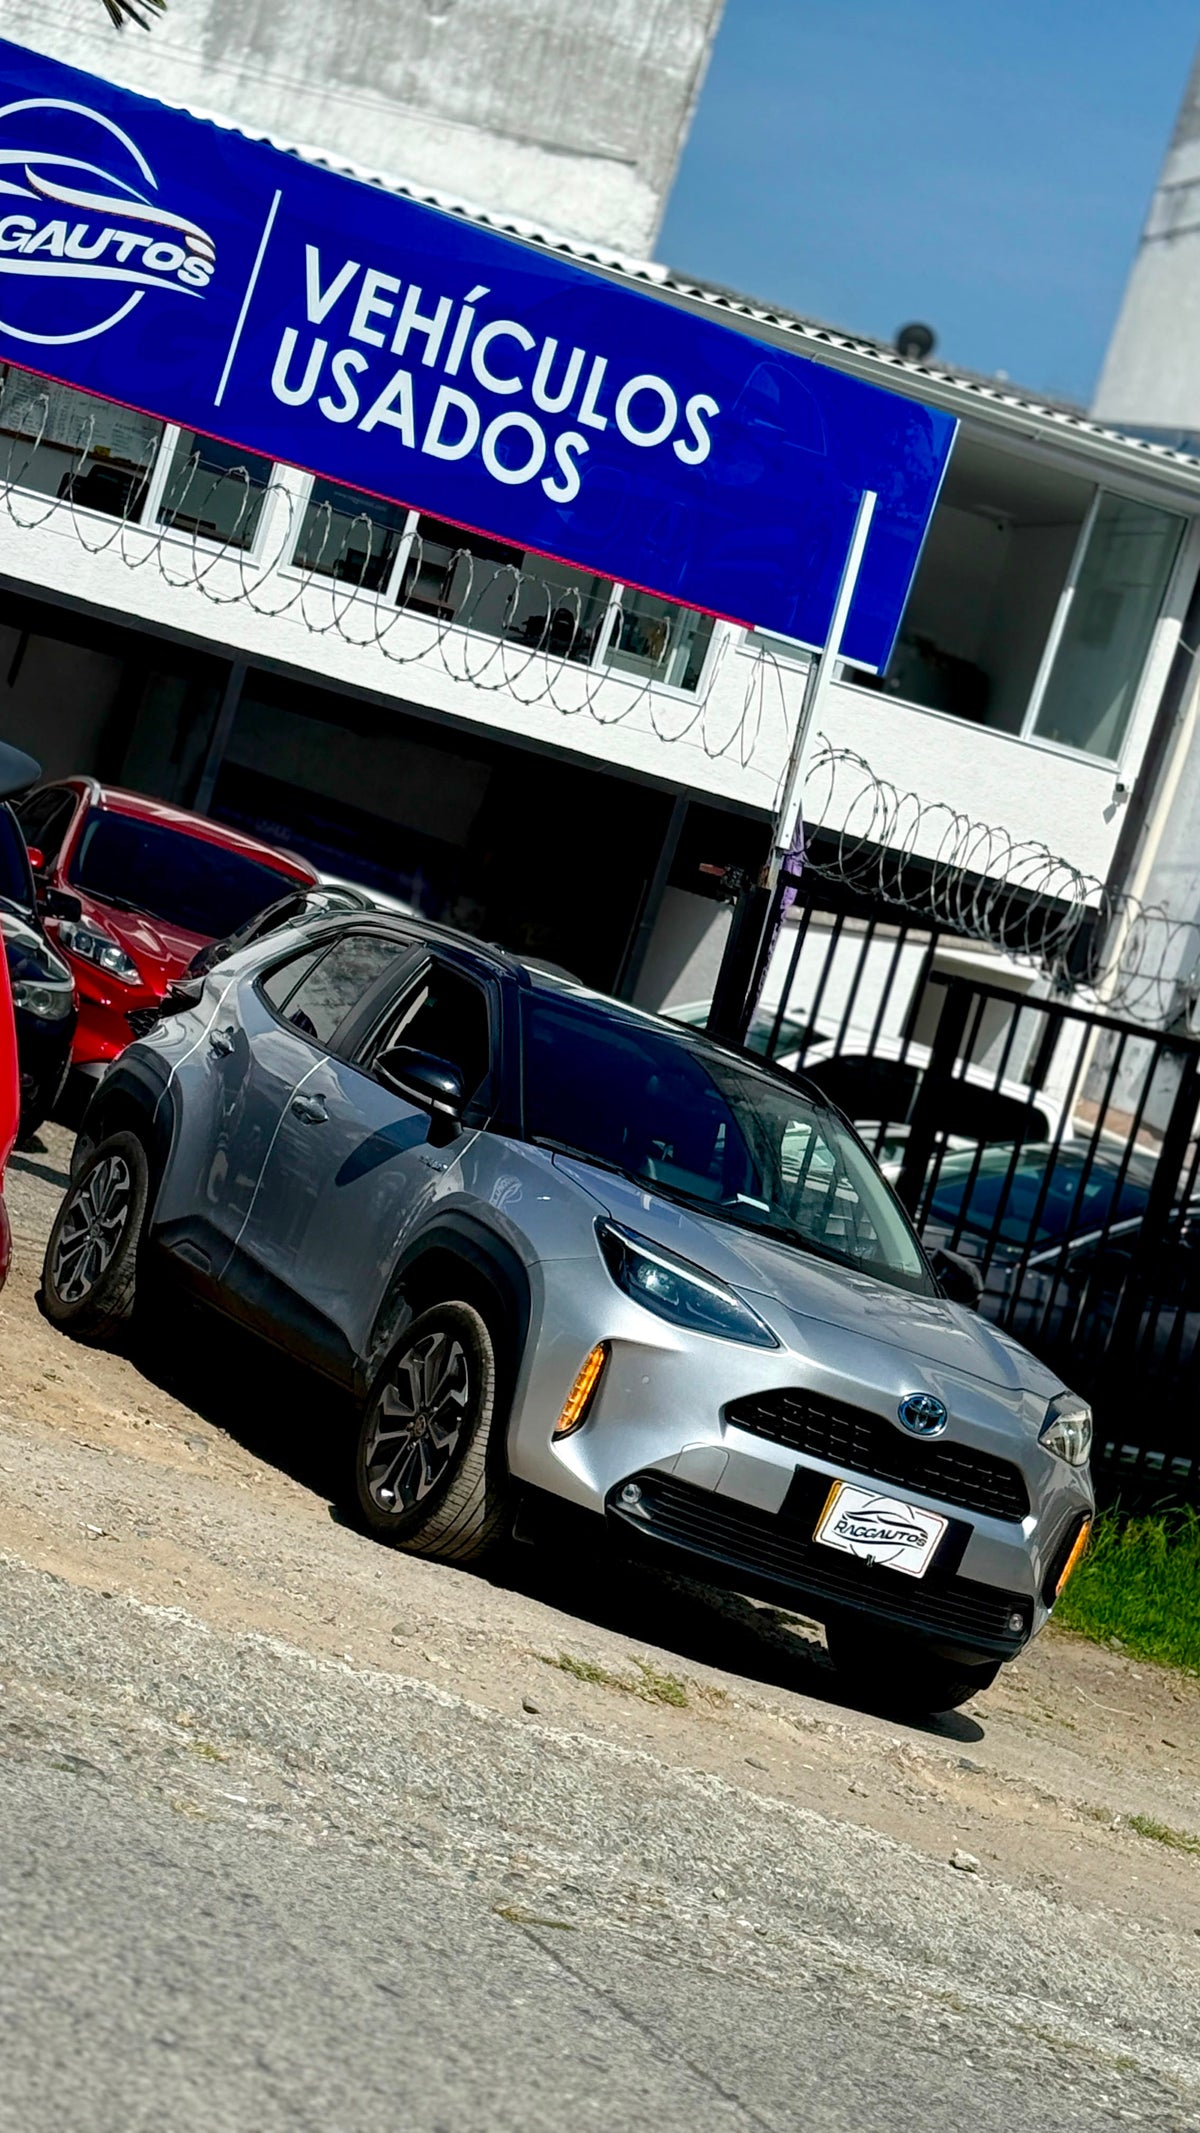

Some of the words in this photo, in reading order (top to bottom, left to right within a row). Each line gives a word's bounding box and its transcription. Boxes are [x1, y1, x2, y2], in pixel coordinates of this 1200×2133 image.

[0, 215, 216, 287] GAUTOS
[271, 326, 590, 504] USADOS
[305, 244, 720, 466] VEHÍCULOS
[833, 1520, 928, 1548] RAGGAUTOS
